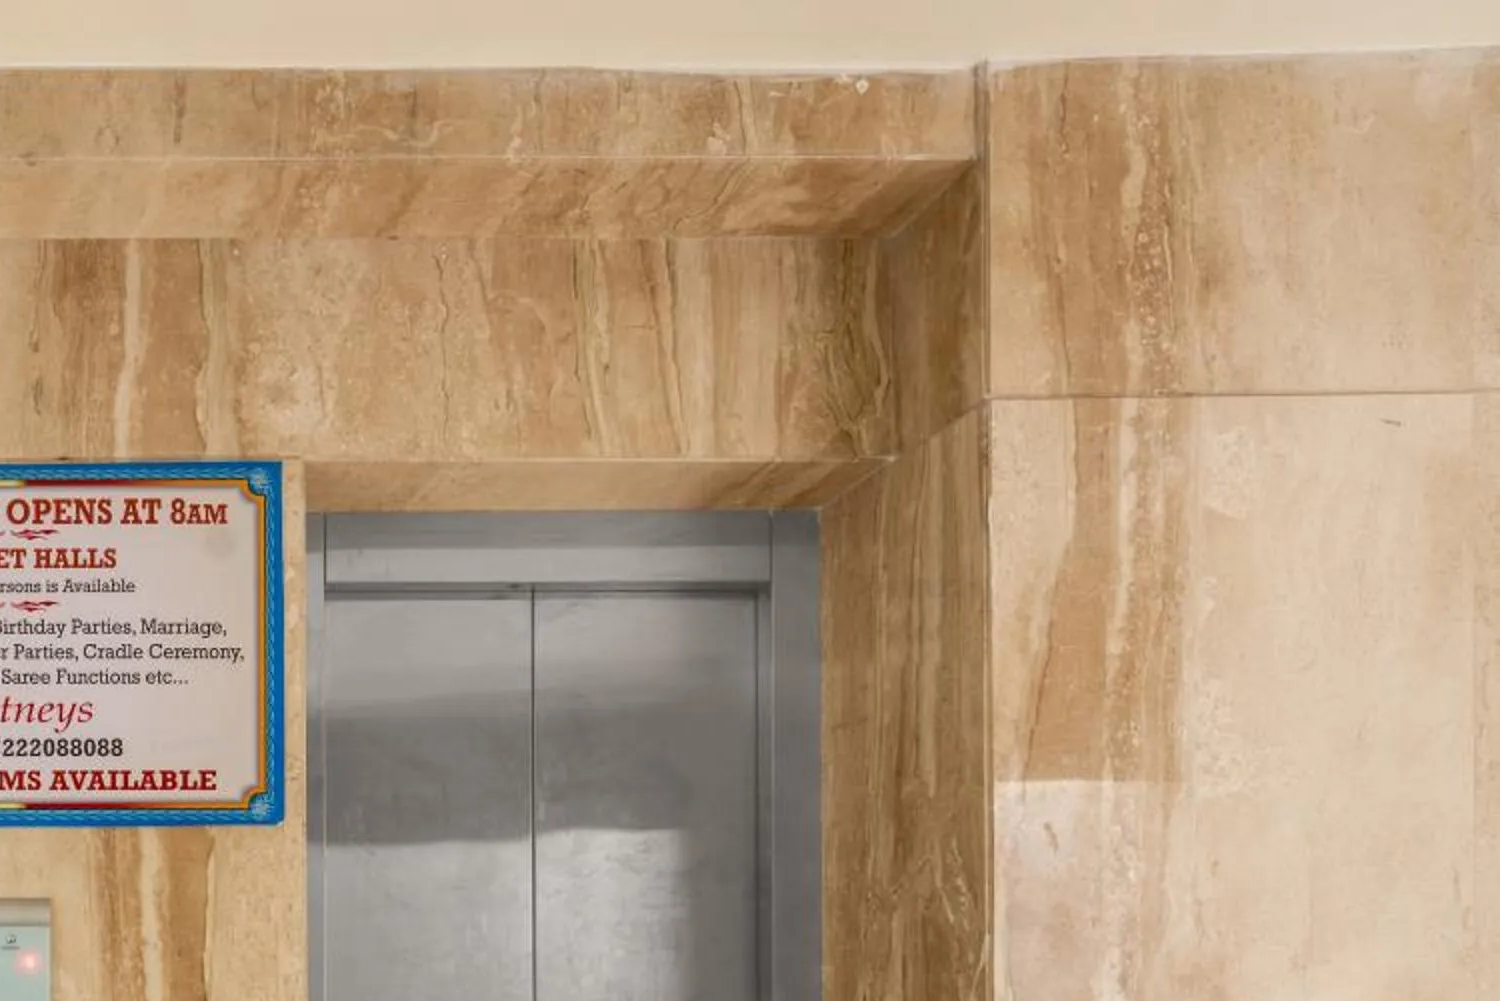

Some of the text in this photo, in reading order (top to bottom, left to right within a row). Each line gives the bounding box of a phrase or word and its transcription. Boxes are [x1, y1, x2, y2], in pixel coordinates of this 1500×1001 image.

[6, 498, 112, 525] OPENS
[120, 499, 162, 525] AT
[33, 547, 117, 569] HALLS
[46, 580, 58, 593] is
[62, 578, 136, 593] Available
[71, 618, 136, 636] Parties,
[140, 618, 227, 638] Marriage,
[13, 644, 78, 662] Parties,
[83, 644, 143, 660] Cradle
[149, 644, 244, 664] Ceremony,
[1, 668, 51, 685] Saree
[56, 668, 141, 685] Functions
[145, 670, 188, 684] etc...
[49, 770, 217, 790] AVAILABLE
